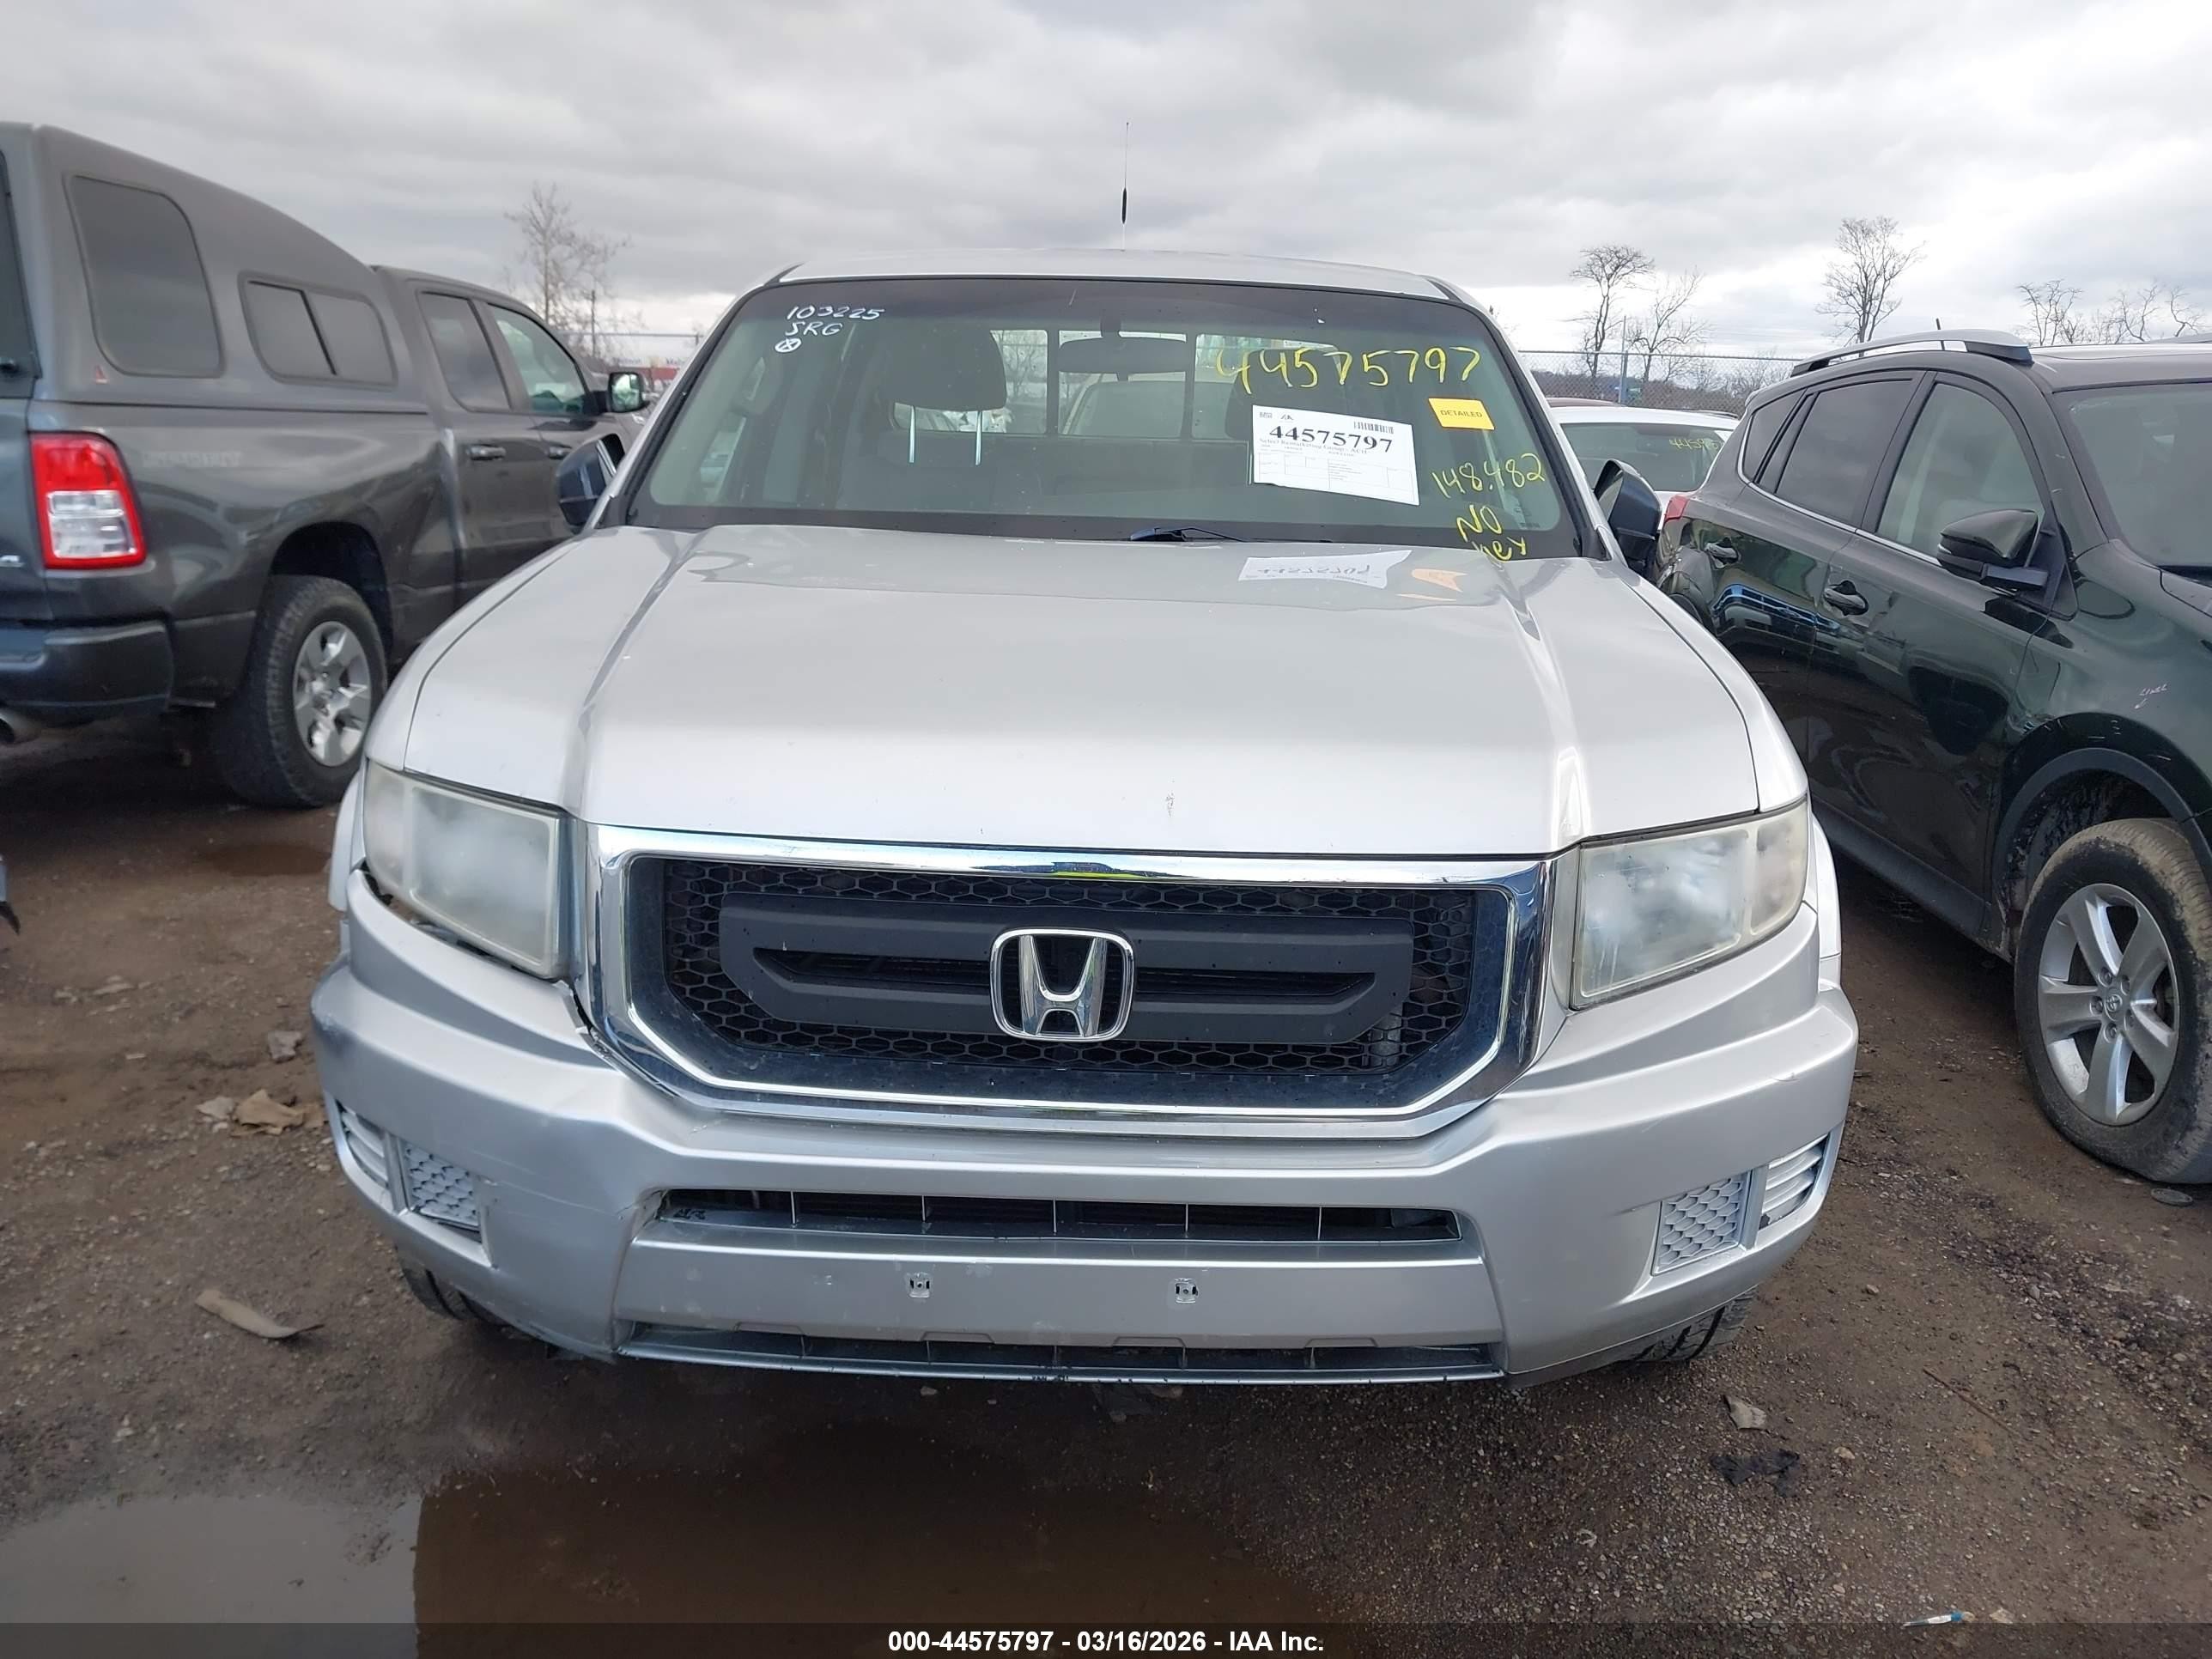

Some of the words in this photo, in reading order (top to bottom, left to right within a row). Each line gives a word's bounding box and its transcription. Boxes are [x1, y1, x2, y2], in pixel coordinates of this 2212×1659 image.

[787, 305, 885, 320] 103225
[1216, 346, 1480, 395] 44575797
[1440, 409, 1483, 418] DETAILED
[1269, 425, 1393, 453] 44575797
[1456, 504, 1502, 543] NO
